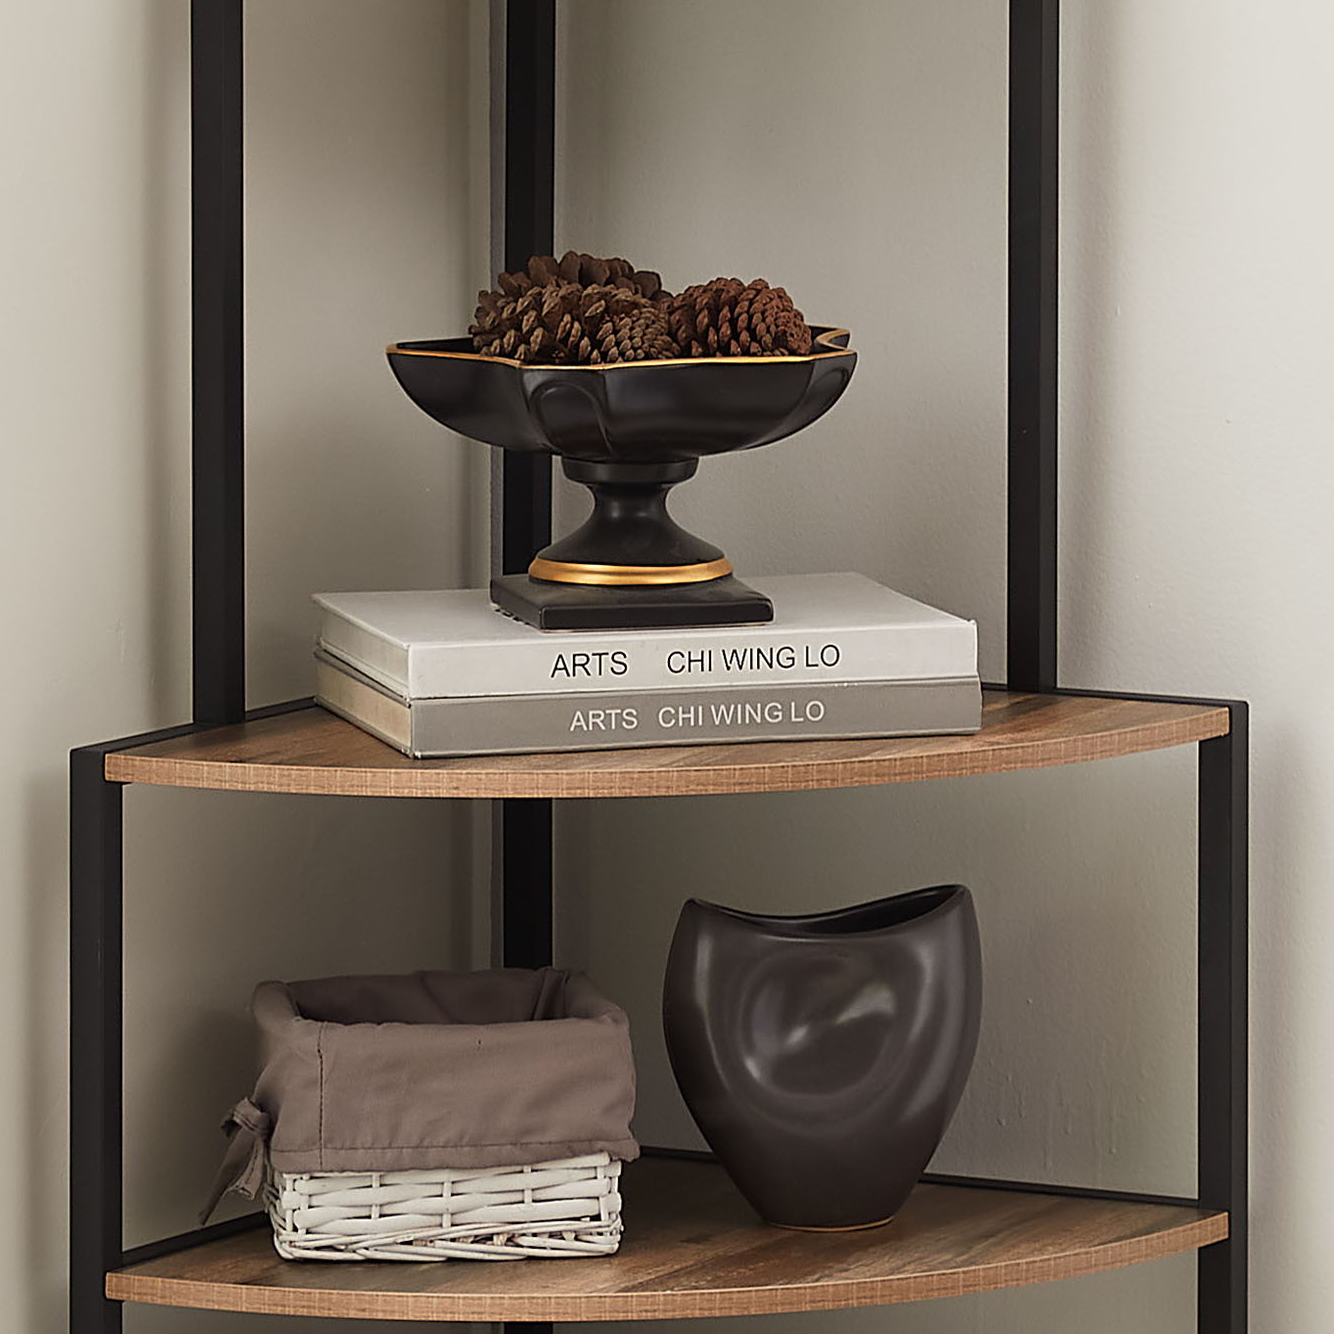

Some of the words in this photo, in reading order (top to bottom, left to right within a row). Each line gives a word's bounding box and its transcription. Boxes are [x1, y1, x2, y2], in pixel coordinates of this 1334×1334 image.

[550, 651, 628, 678] ARTS
[667, 650, 712, 674] CHI
[722, 646, 795, 671] WING
[805, 644, 840, 668] LO
[570, 708, 638, 732] ARTS
[658, 705, 703, 728] CHI
[710, 702, 783, 726] WING
[790, 700, 825, 722] LO
